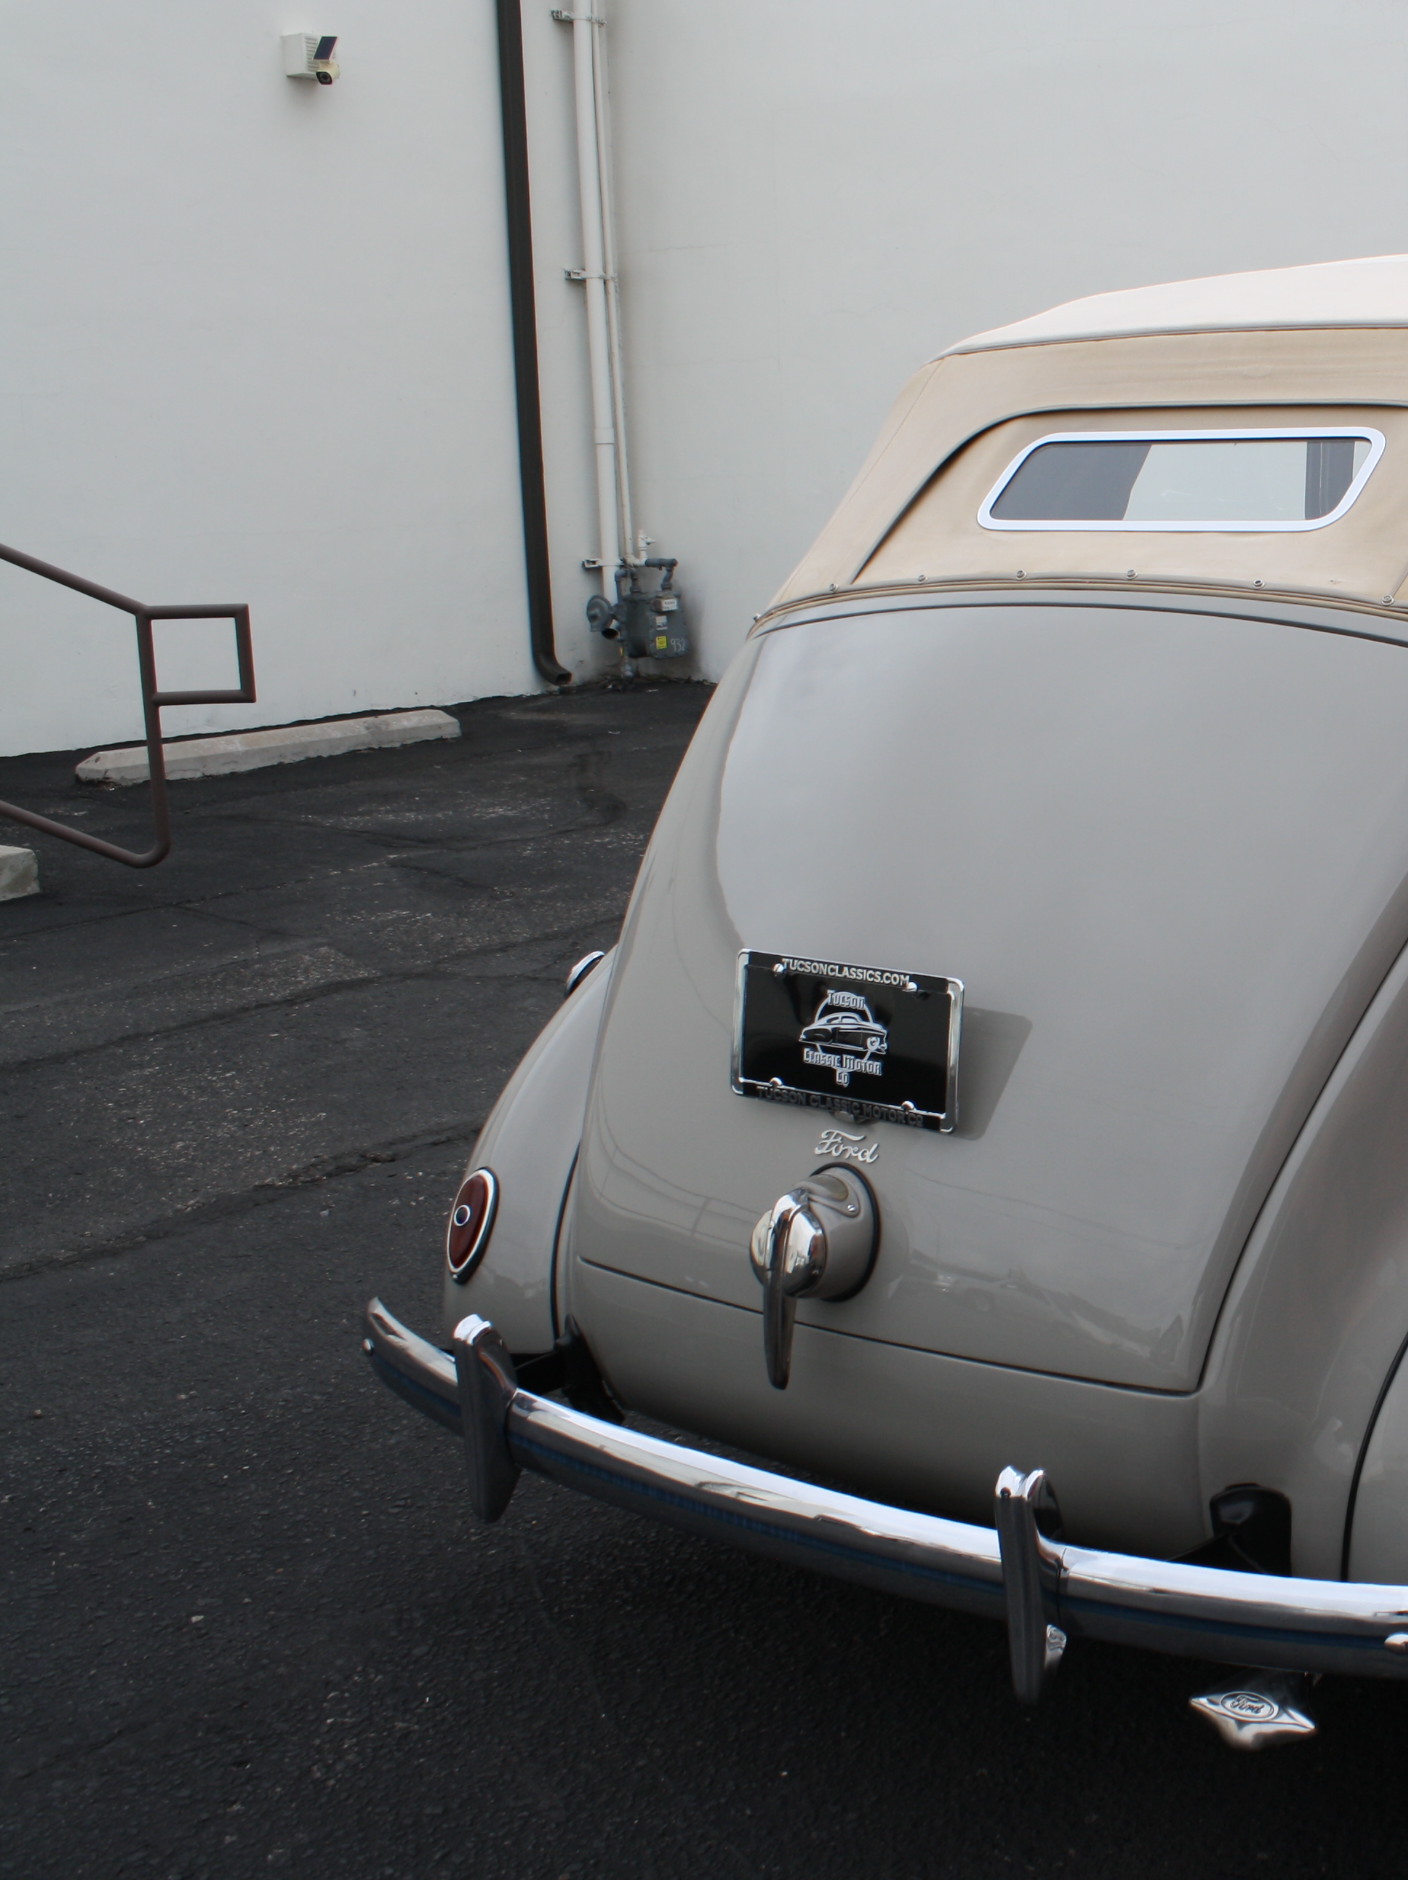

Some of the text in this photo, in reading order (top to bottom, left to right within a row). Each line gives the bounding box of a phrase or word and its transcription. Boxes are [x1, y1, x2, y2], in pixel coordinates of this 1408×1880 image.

[782, 958, 910, 985] TUCSONCLASSICS.COM
[757, 1086, 807, 1105] TUCSON
[810, 1095, 861, 1113] CLASSIC
[863, 1103, 906, 1124] MOTOR
[814, 1129, 879, 1164] Ford
[1230, 1694, 1264, 1714] Ford
